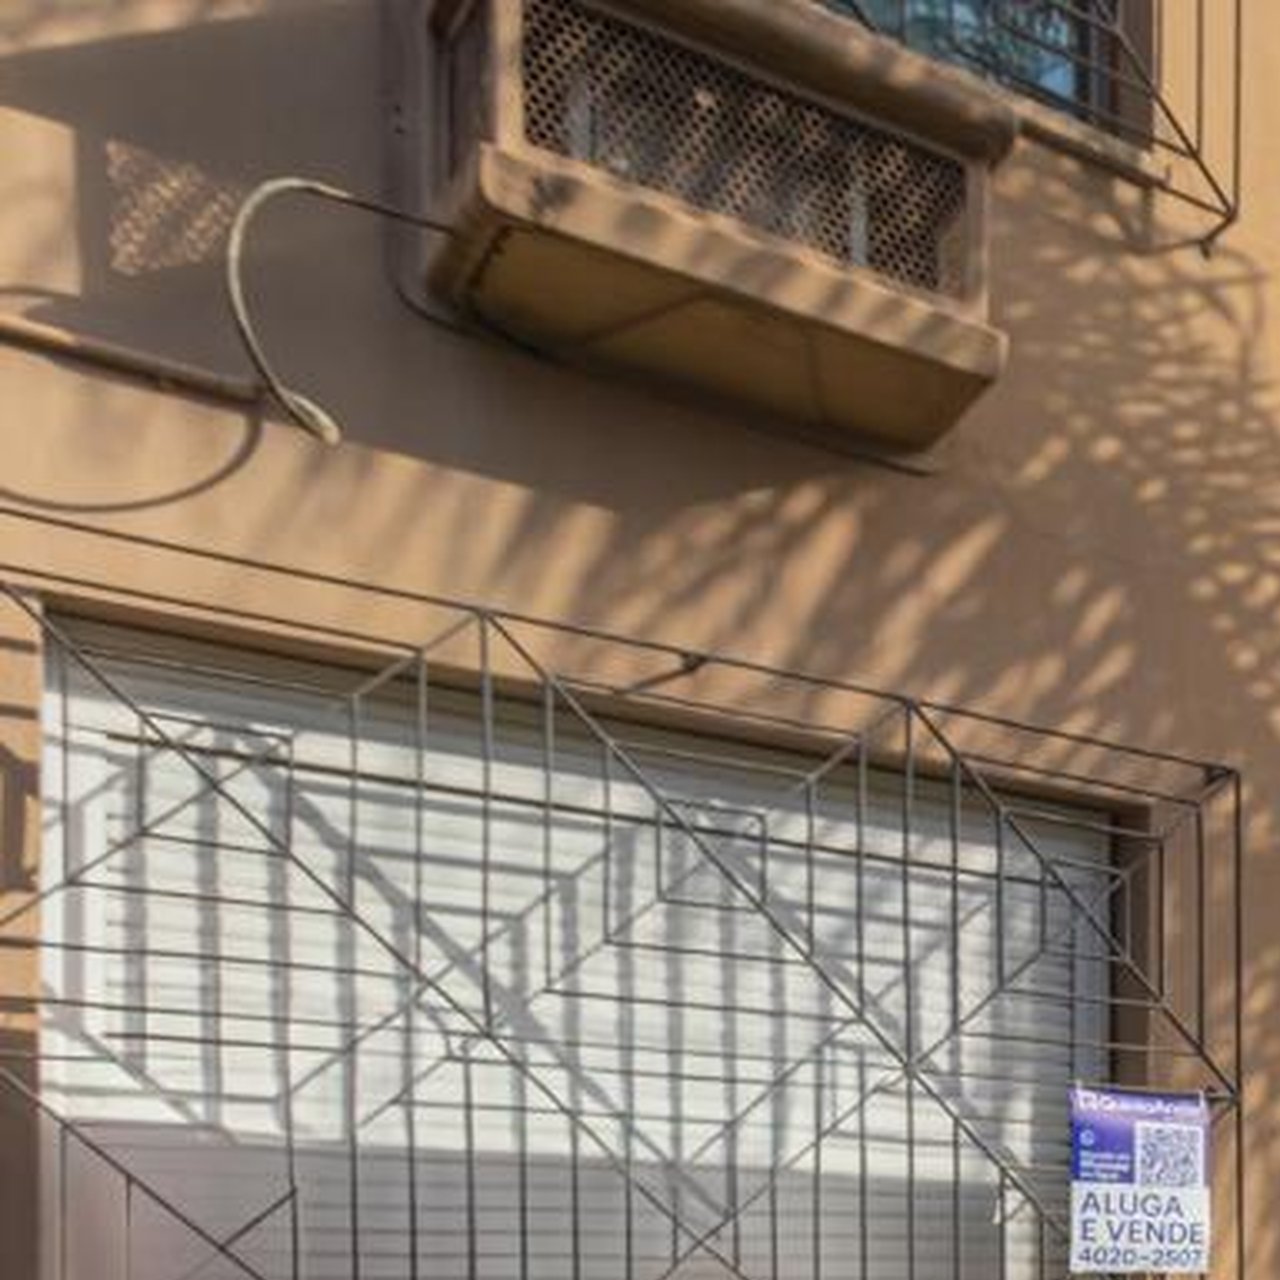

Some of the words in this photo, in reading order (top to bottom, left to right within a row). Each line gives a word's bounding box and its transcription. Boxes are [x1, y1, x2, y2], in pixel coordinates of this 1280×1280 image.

[1081, 1191, 1184, 1218] ALUGA
[1081, 1219, 1098, 1243] E
[1107, 1220, 1203, 1245] VENDE
[1078, 1247, 1202, 1267] 4020-2507
